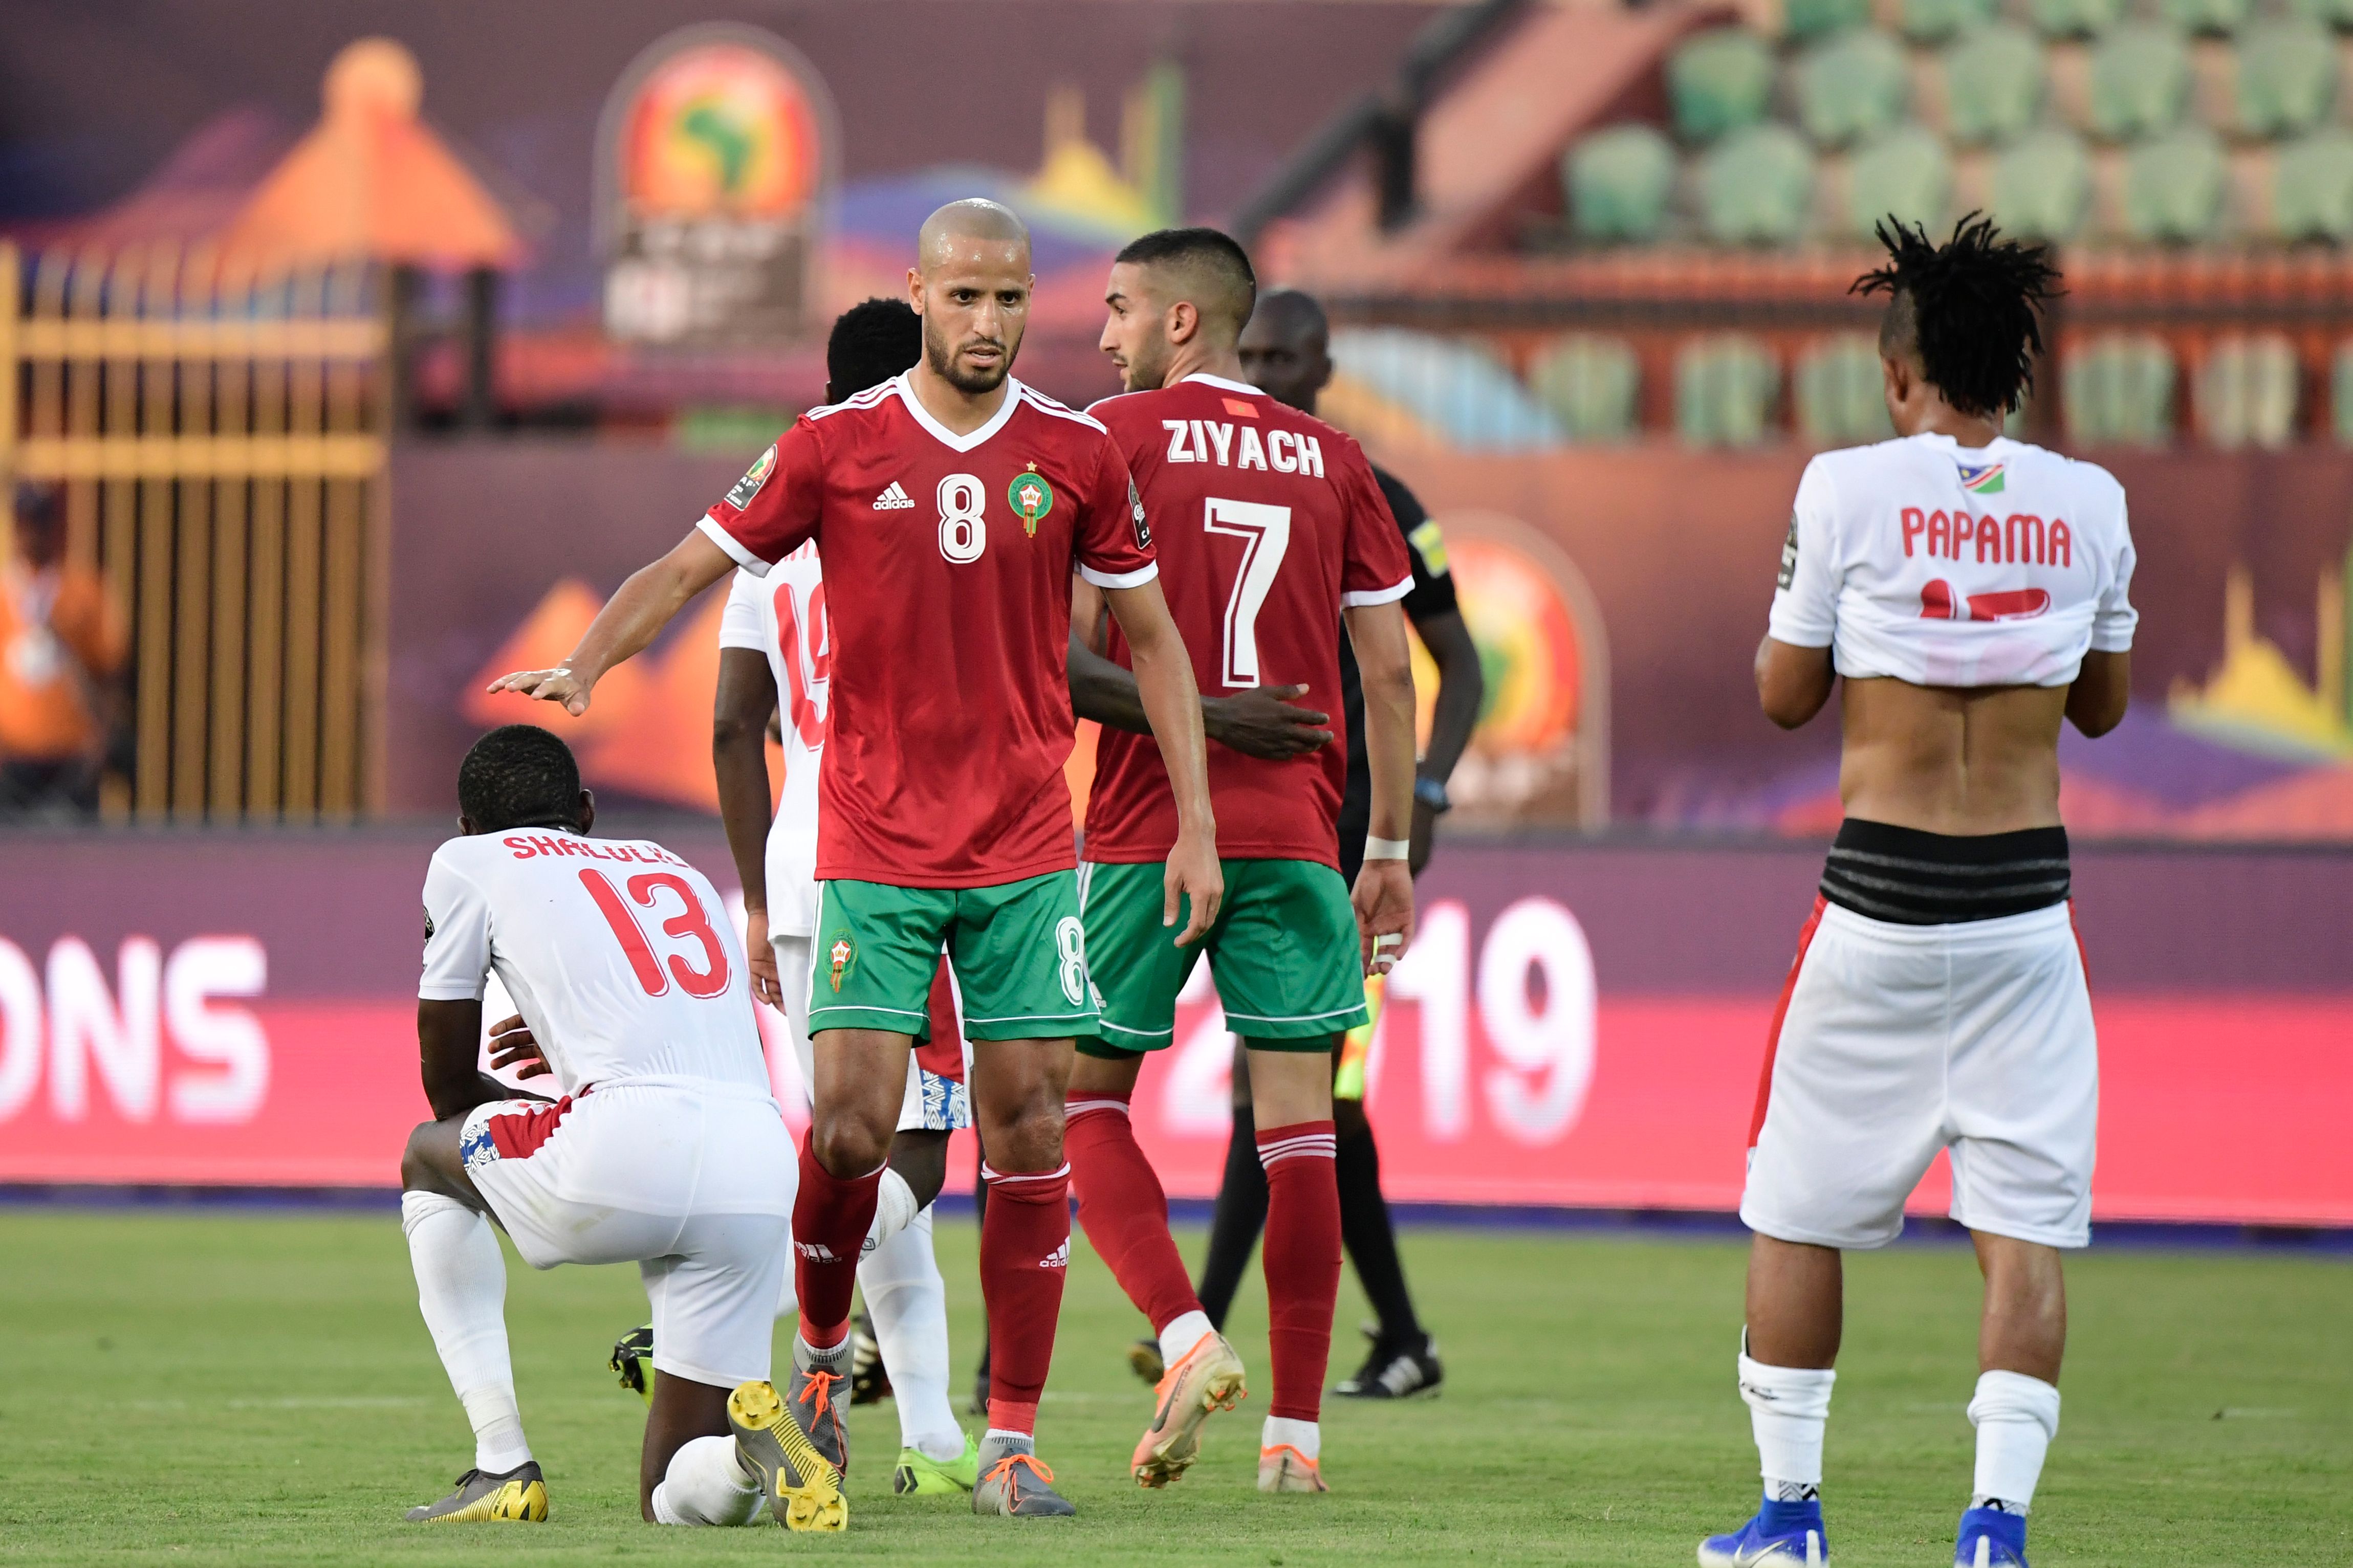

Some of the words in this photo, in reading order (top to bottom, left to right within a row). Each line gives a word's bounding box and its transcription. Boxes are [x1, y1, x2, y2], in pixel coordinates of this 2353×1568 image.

[1162, 419, 1324, 478] ZIYACH
[873, 499, 915, 510] adidas
[937, 474, 986, 564] 8
[1901, 506, 2071, 568] PAPAMA
[1204, 497, 1291, 688] 7
[578, 868, 732, 1000] 13
[1056, 916, 1084, 1006] 8
[1039, 1257, 1069, 1268] adid
